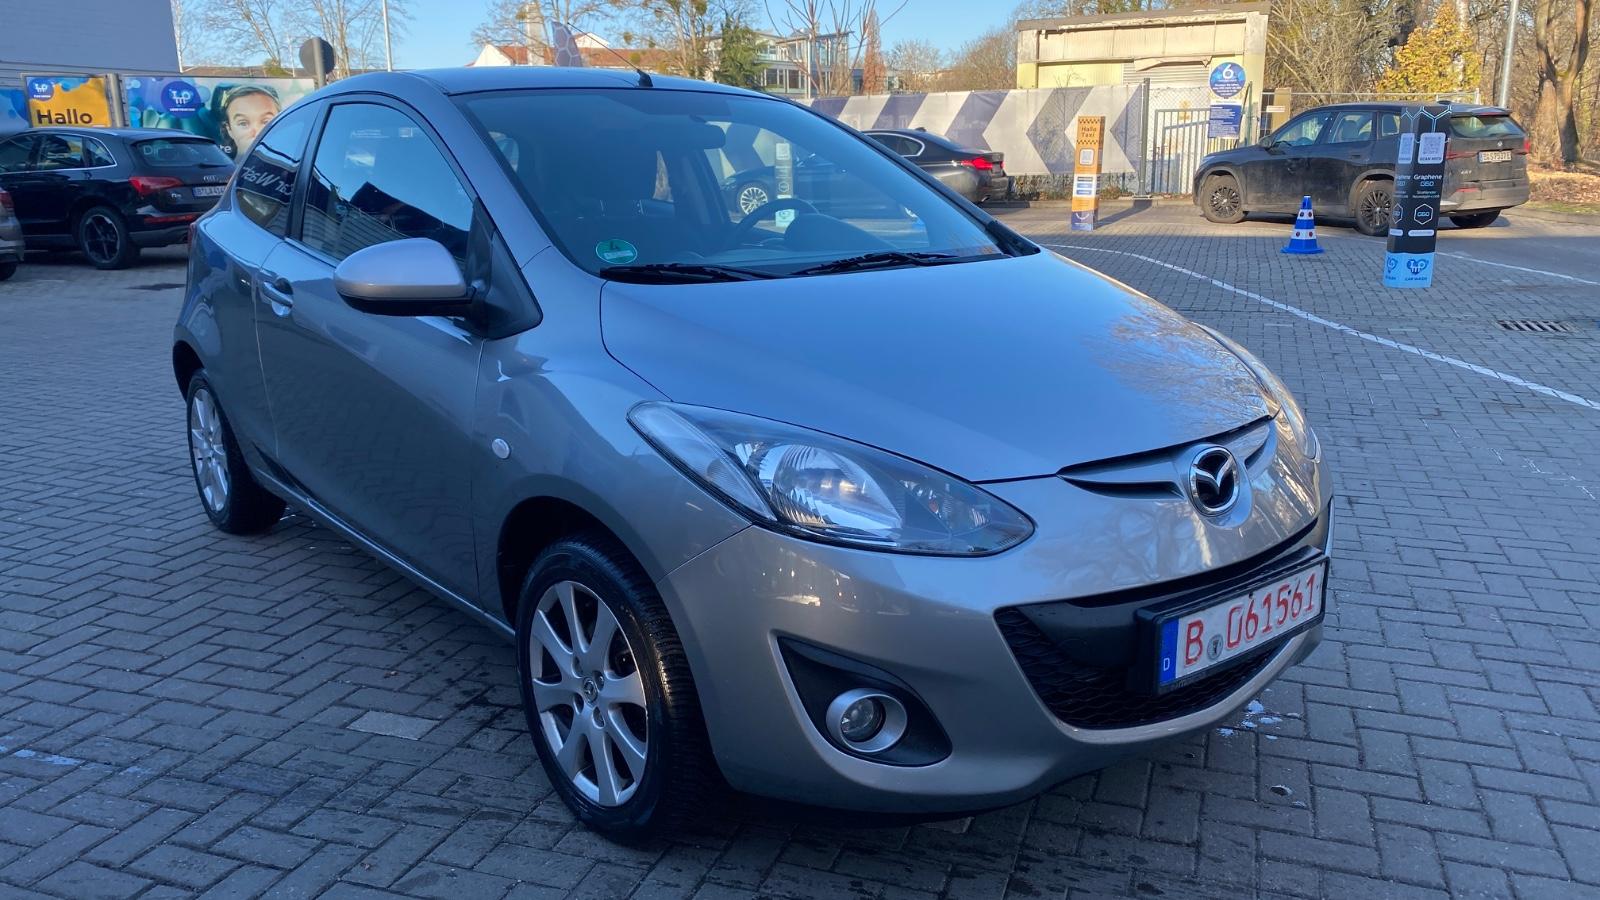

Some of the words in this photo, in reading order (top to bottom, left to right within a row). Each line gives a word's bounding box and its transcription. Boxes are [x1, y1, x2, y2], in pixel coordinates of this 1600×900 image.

[1222, 64, 1234, 79] 6
[36, 109, 93, 125] Hallo
[1184, 619, 1203, 666] B
[1226, 573, 1315, 649] 061561
[1163, 657, 1170, 672] D
